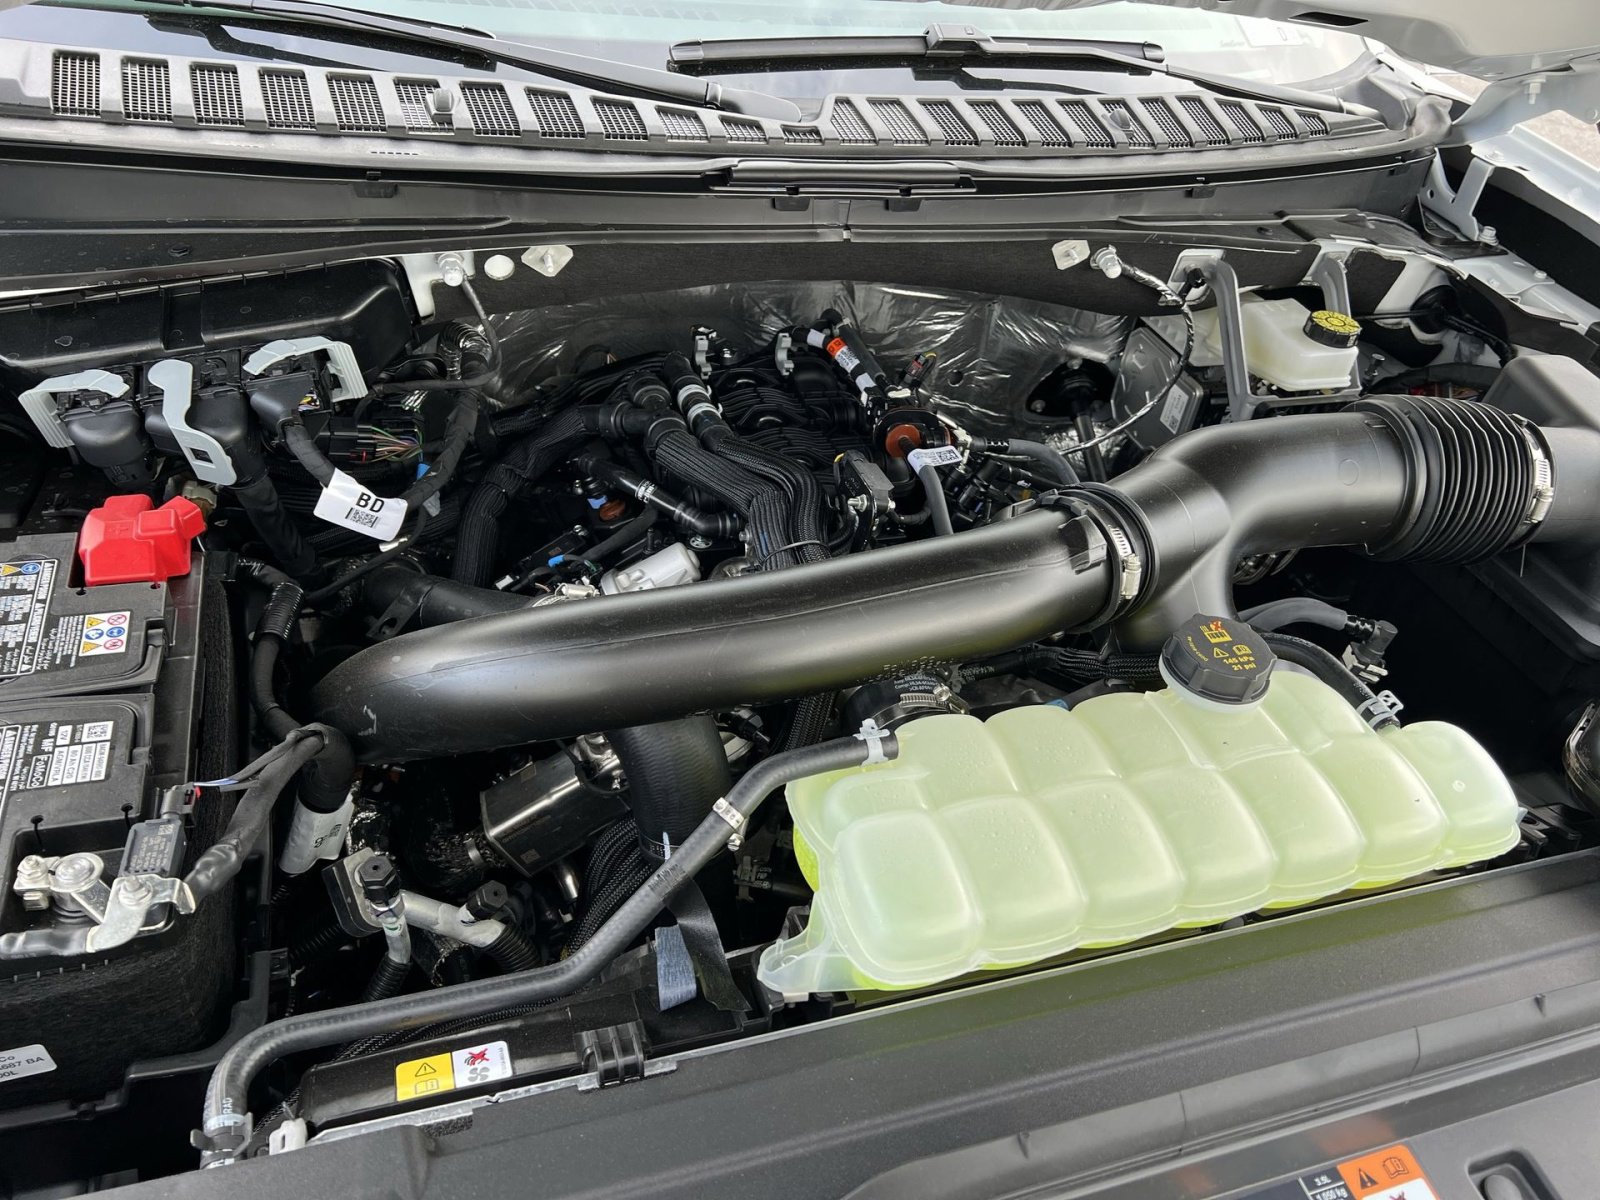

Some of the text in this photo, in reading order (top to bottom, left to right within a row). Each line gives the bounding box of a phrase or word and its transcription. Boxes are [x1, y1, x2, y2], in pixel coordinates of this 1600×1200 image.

[356, 492, 385, 513] BD
[1239, 655, 1255, 663] kPa
[1244, 663, 1257, 671] psi
[60, 730, 69, 740] 12V
[31, 756, 48, 787] FoMoCo
[25, 1056, 45, 1065] BA
[222, 1097, 233, 1114] RAD
